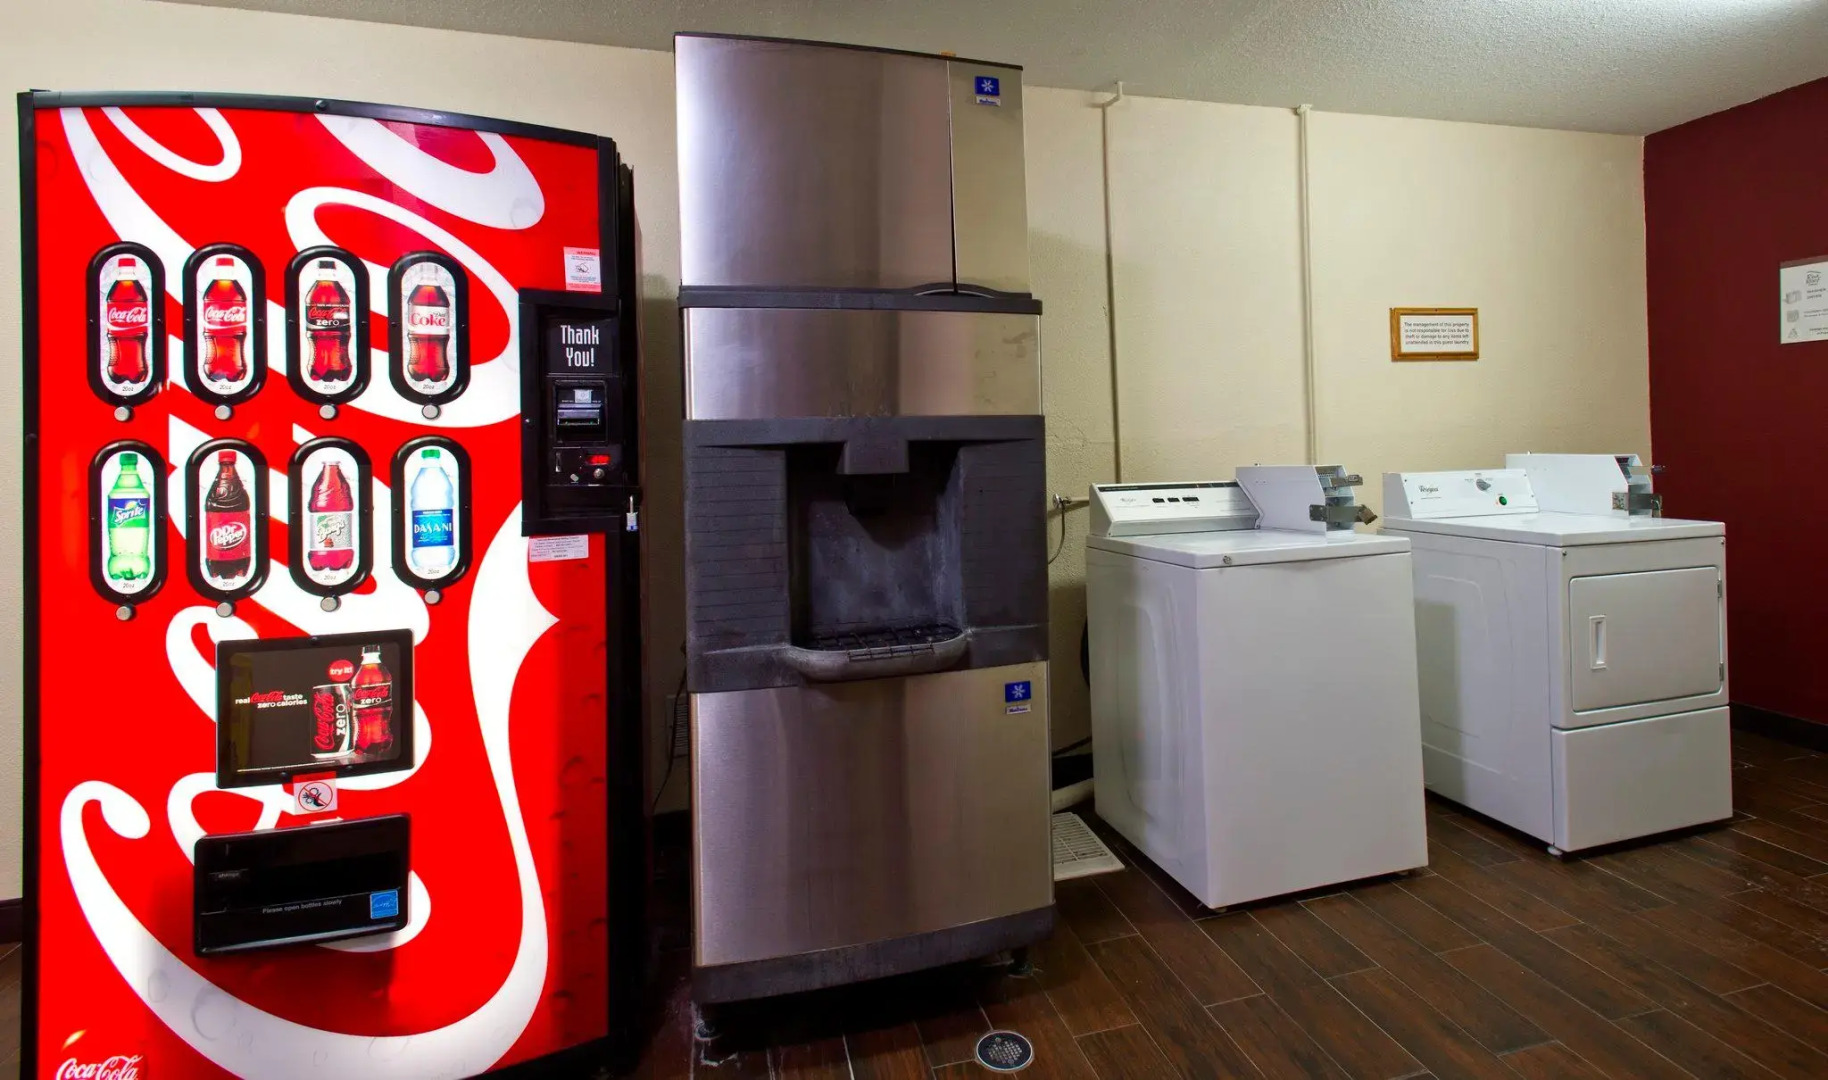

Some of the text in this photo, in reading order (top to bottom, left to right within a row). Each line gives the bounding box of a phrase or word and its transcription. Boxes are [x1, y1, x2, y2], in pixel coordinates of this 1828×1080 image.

[108, 307, 147, 323] Coca-Cola
[205, 306, 246, 322] Coca-Cola
[411, 313, 446, 326] Coke
[560, 325, 599, 344] Thank
[566, 347, 594, 367] You!
[114, 506, 144, 524] Sprite
[222, 525, 237, 535] Dr
[414, 522, 452, 534] DASANI
[212, 527, 243, 546] Pepper
[276, 699, 308, 707] calories
[360, 697, 382, 705] zero
[335, 704, 346, 736] zero
[262, 906, 283, 914] Please
[301, 901, 322, 909] bottles
[55, 1054, 143, 1080] Coca-Cola
